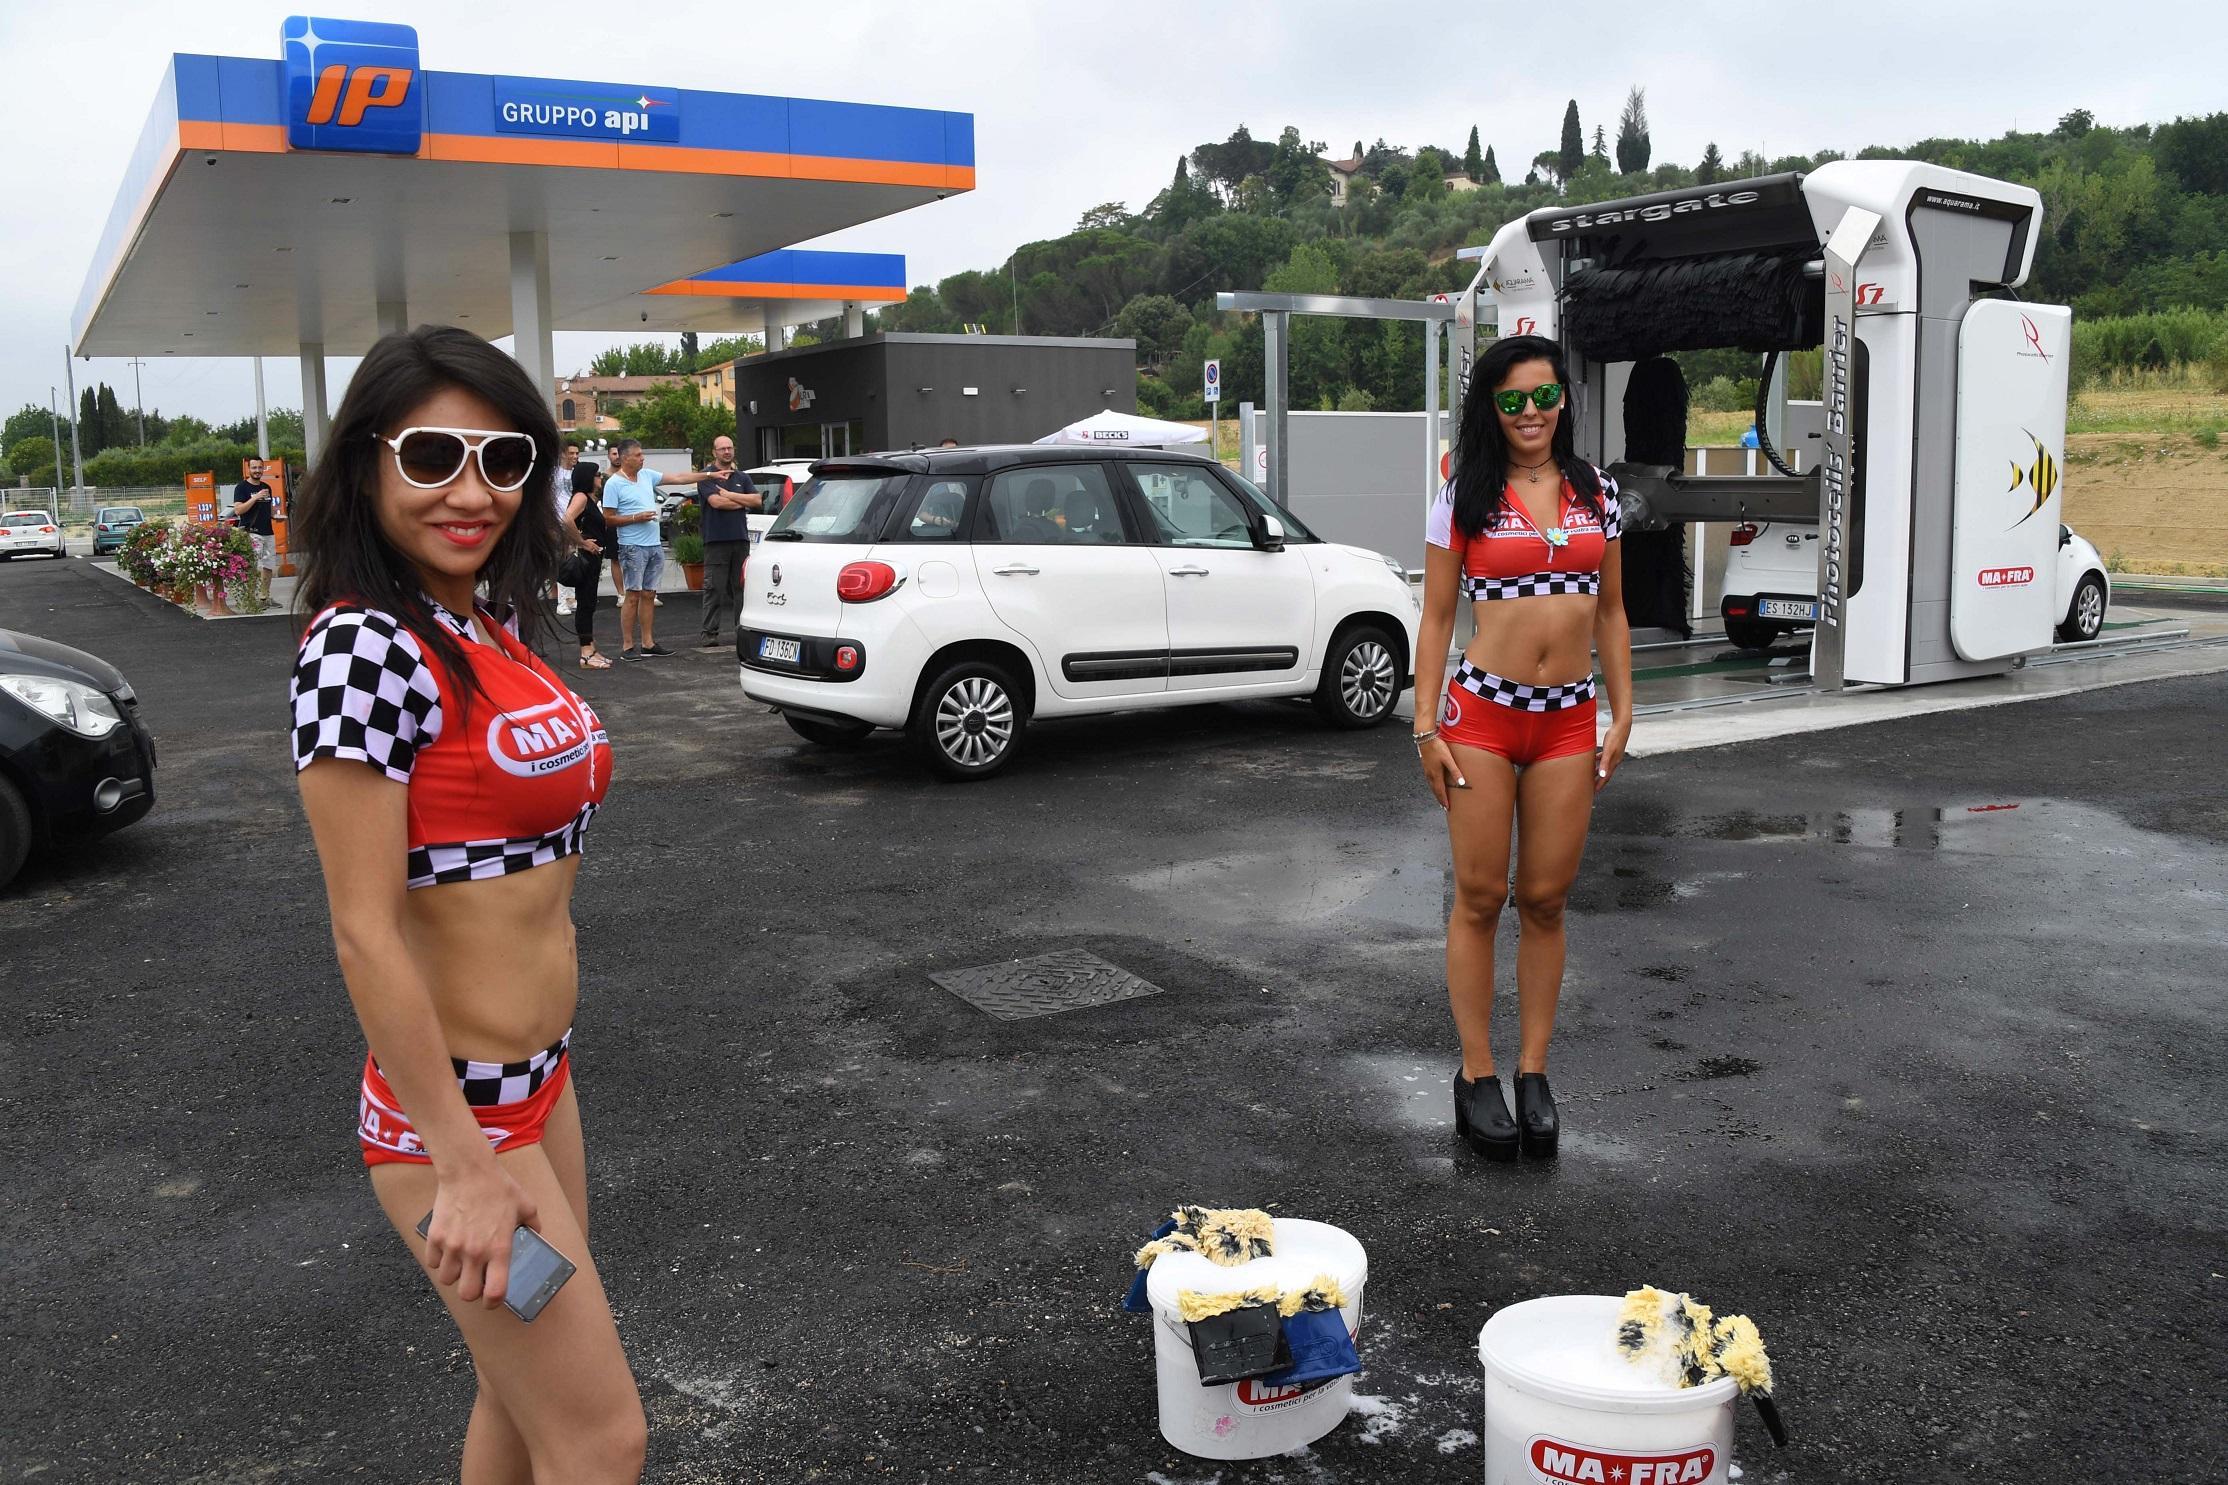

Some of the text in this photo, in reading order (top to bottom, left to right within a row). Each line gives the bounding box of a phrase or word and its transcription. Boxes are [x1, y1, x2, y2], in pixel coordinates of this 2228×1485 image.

[305, 63, 414, 127] IP
[502, 102, 649, 135] GRUPPO api
[1551, 191, 1760, 232] stargate
[1926, 195, 1981, 210] www.aquarama.it
[1856, 283, 1885, 304] S7
[1510, 317, 1536, 336] S7
[1826, 315, 1847, 436] Barrier
[1095, 431, 1128, 439] BECK'S
[1766, 602, 1812, 617] ES 132HJ
[777, 640, 799, 661] 136CN
[531, 762, 536, 772] i
[1253, 1405, 1257, 1413] i
[1259, 1397, 1302, 1413] cosmetici
[1302, 1391, 1317, 1404] per
